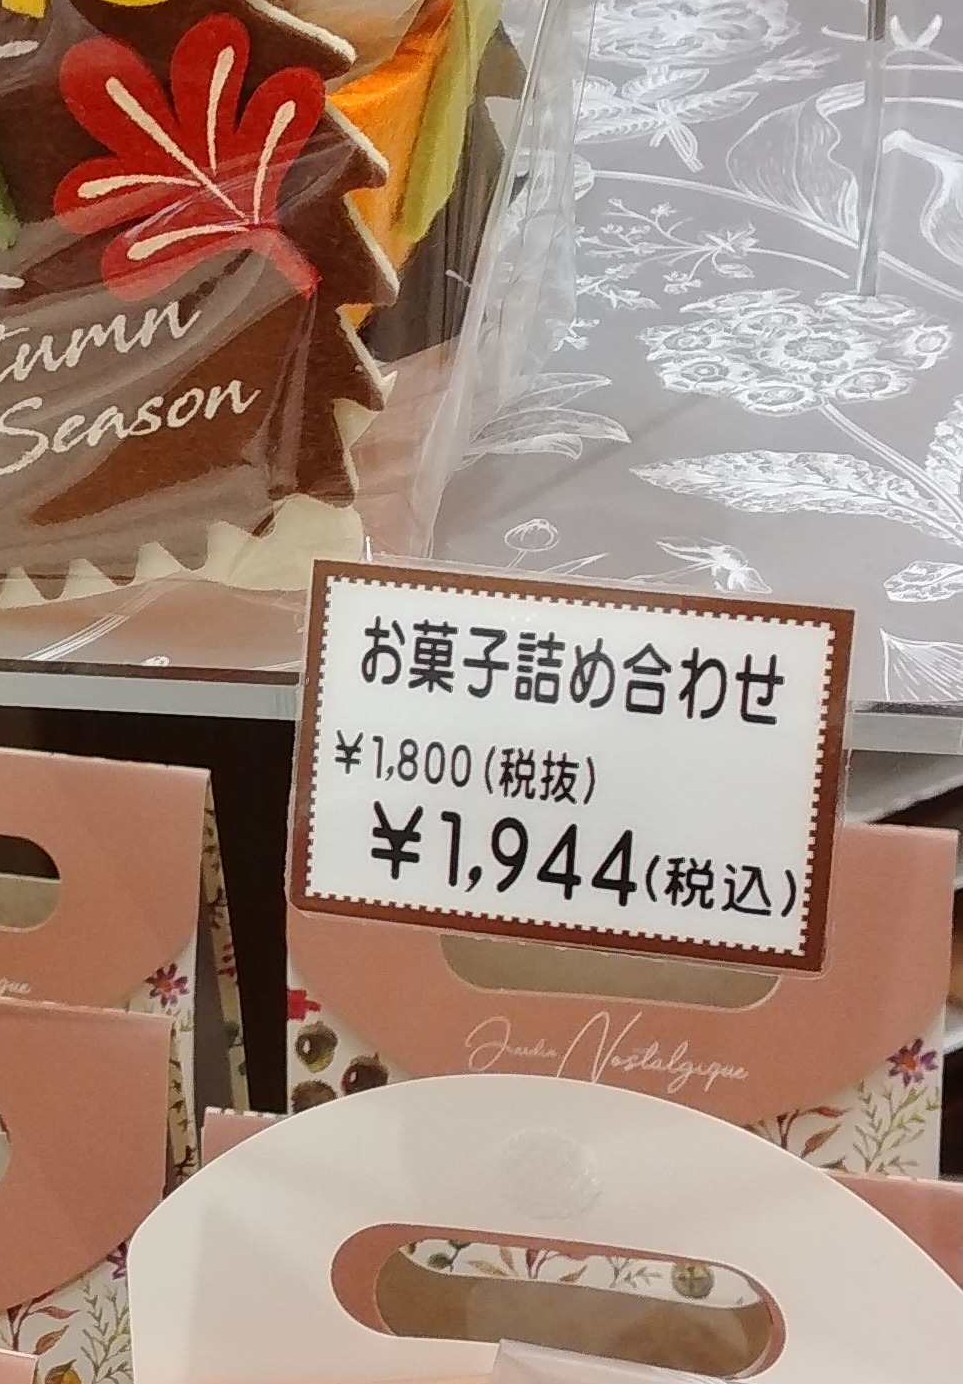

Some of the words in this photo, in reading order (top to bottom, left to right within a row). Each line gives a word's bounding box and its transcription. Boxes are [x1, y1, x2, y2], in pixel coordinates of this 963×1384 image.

[361, 615, 786, 726] お菓子詰め合わせ
